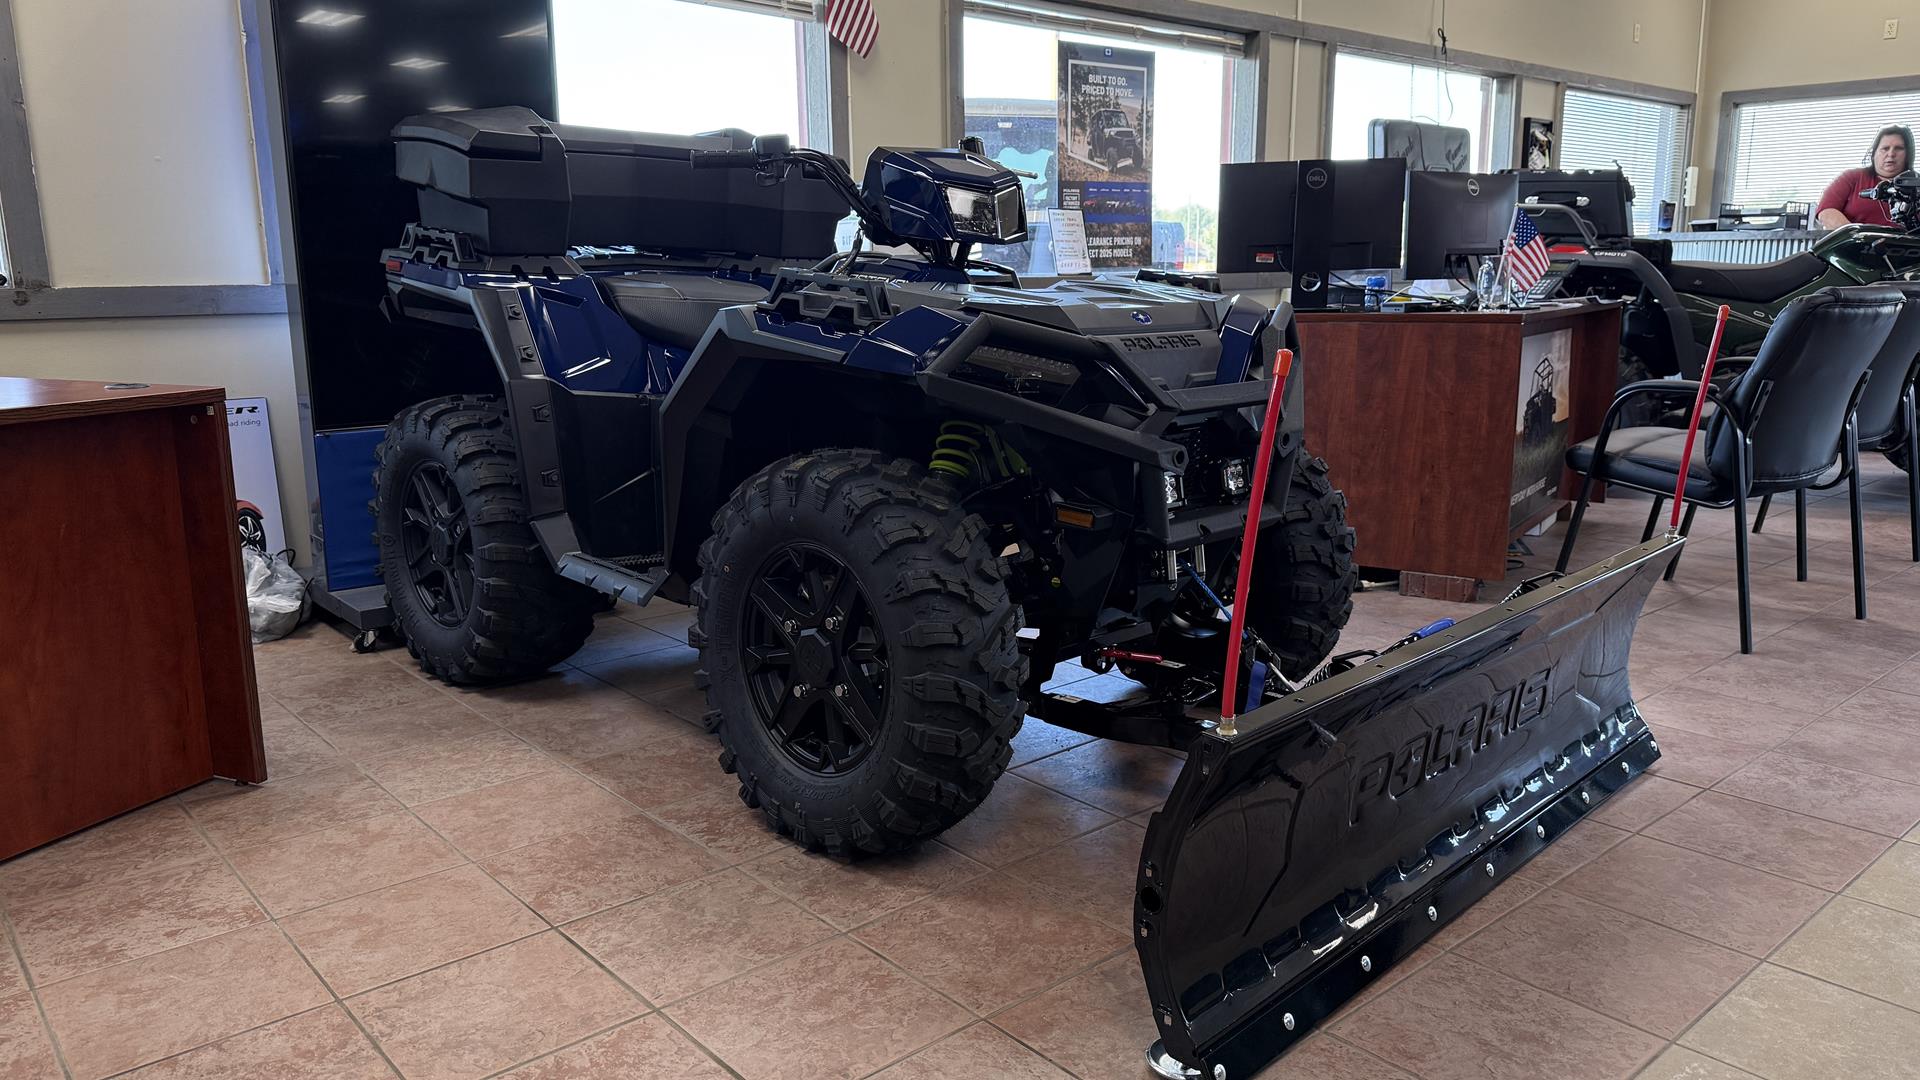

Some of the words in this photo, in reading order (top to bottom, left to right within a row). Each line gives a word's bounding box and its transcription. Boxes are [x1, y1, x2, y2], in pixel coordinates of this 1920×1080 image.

[1088, 74, 1107, 84] BUILT
[1108, 75, 1117, 85] TO
[1117, 76, 1128, 86] GO.
[1081, 84, 1105, 95] PRICED
[1106, 87, 1115, 96] TO
[1115, 87, 1135, 97] MOVE.
[1087, 236, 1113, 246] LEARANCE
[1113, 236, 1133, 246] PRICING
[1134, 236, 1142, 245] ON
[1088, 249, 1099, 258] ECT
[1112, 248, 1133, 258] MODELS
[1119, 334, 1201, 351] POLARIS
[240, 418, 261, 428] riding
[1348, 667, 1552, 828] POLARIS
